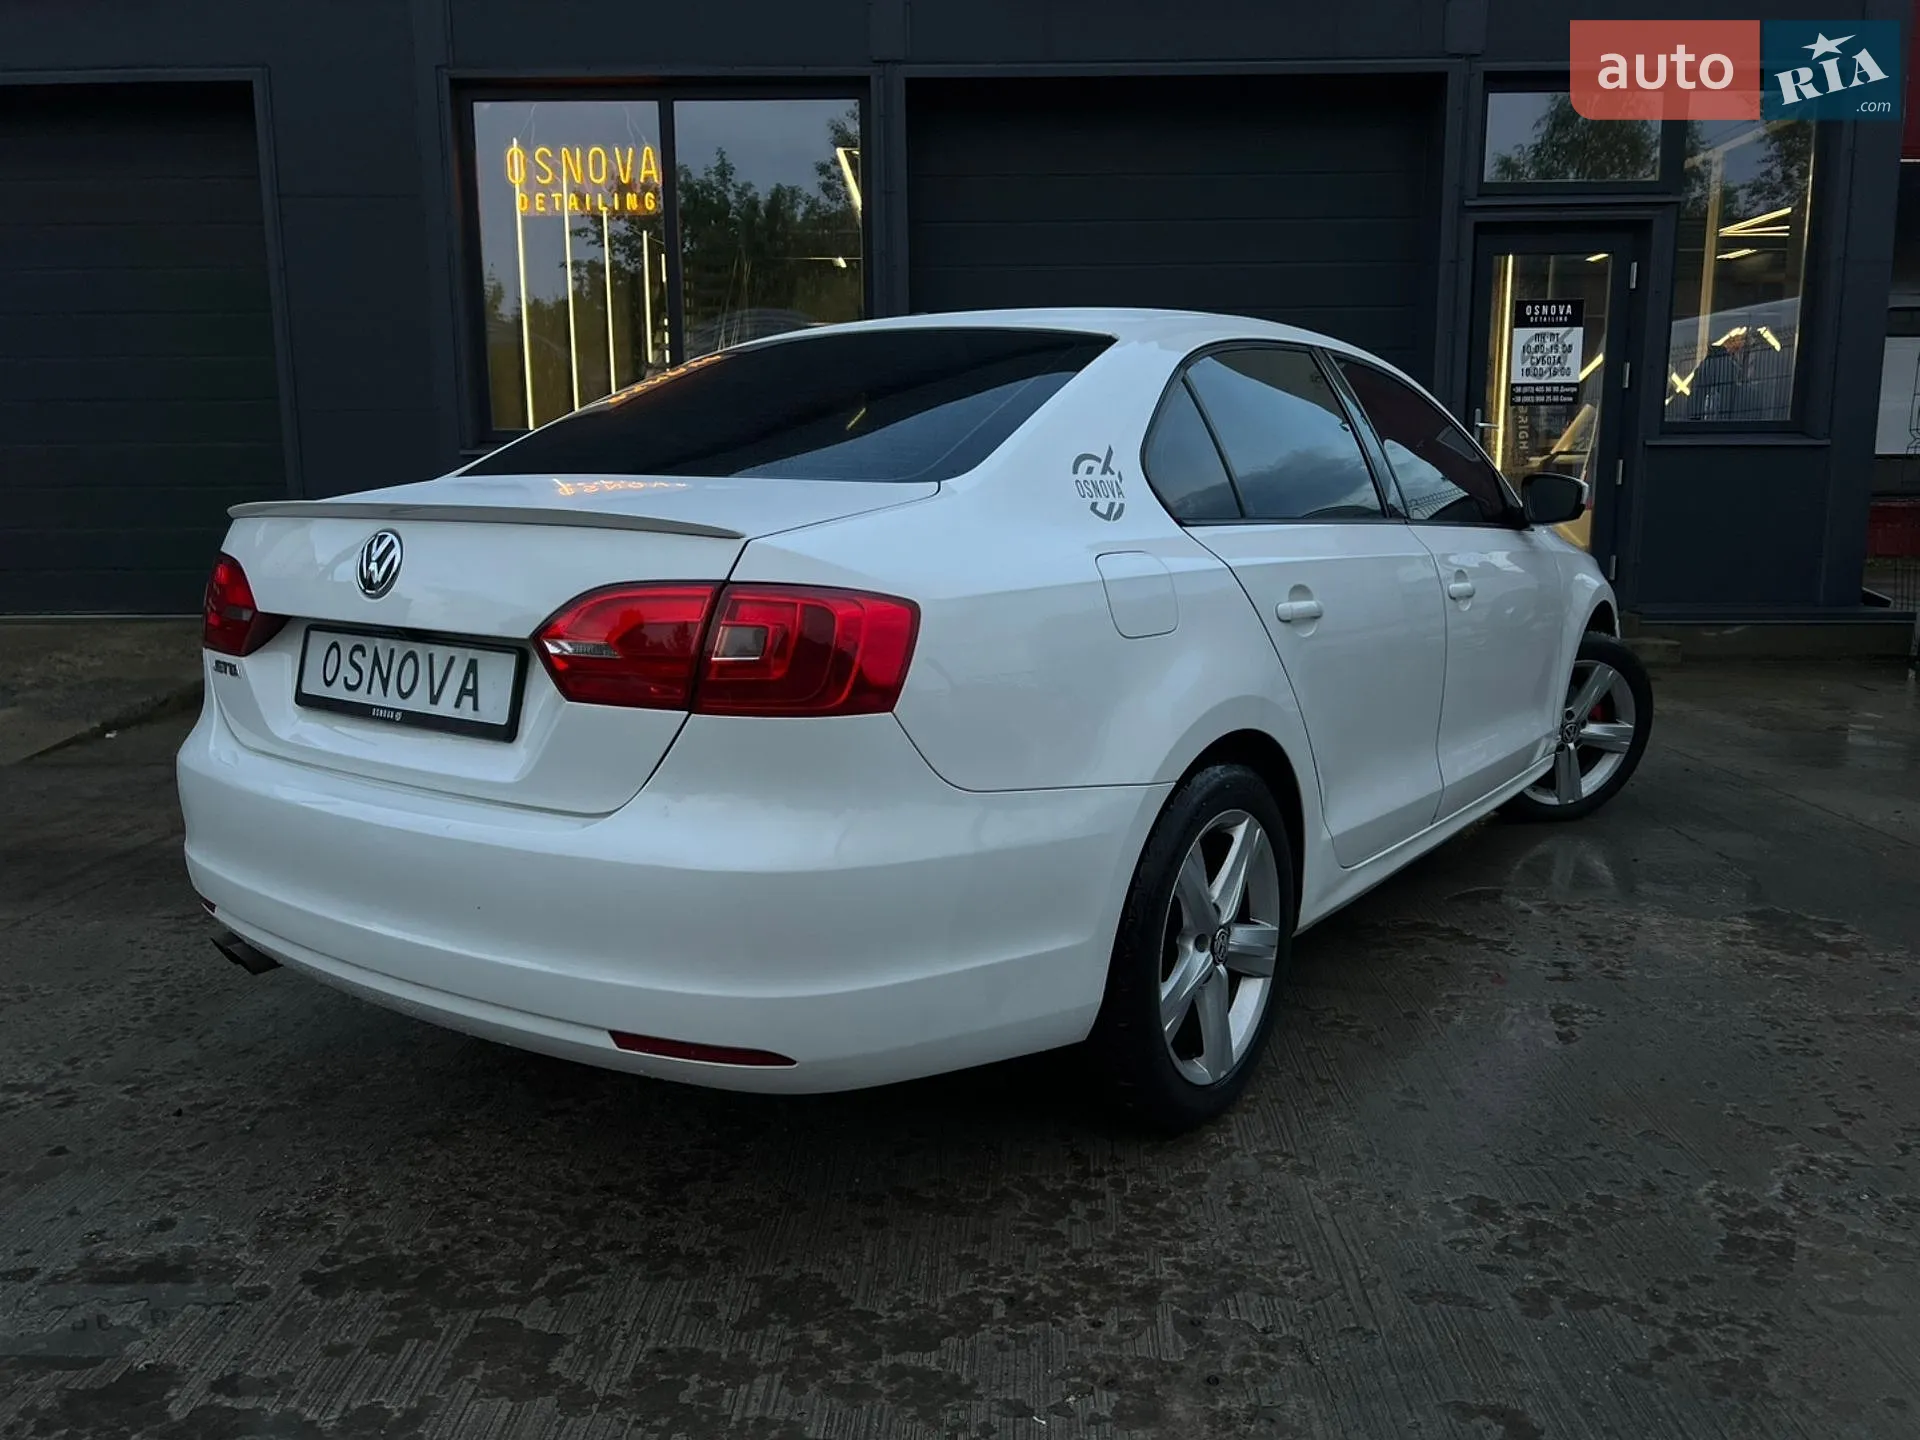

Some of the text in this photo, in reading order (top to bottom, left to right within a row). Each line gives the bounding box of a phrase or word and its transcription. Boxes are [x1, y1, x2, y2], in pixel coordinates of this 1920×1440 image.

[506, 146, 660, 185] OSNOVA
[518, 193, 657, 212] DETAILING
[1525, 304, 1572, 316] OSNOVA
[1074, 479, 1125, 499] OSNOVA
[322, 641, 480, 712] OSNOVA
